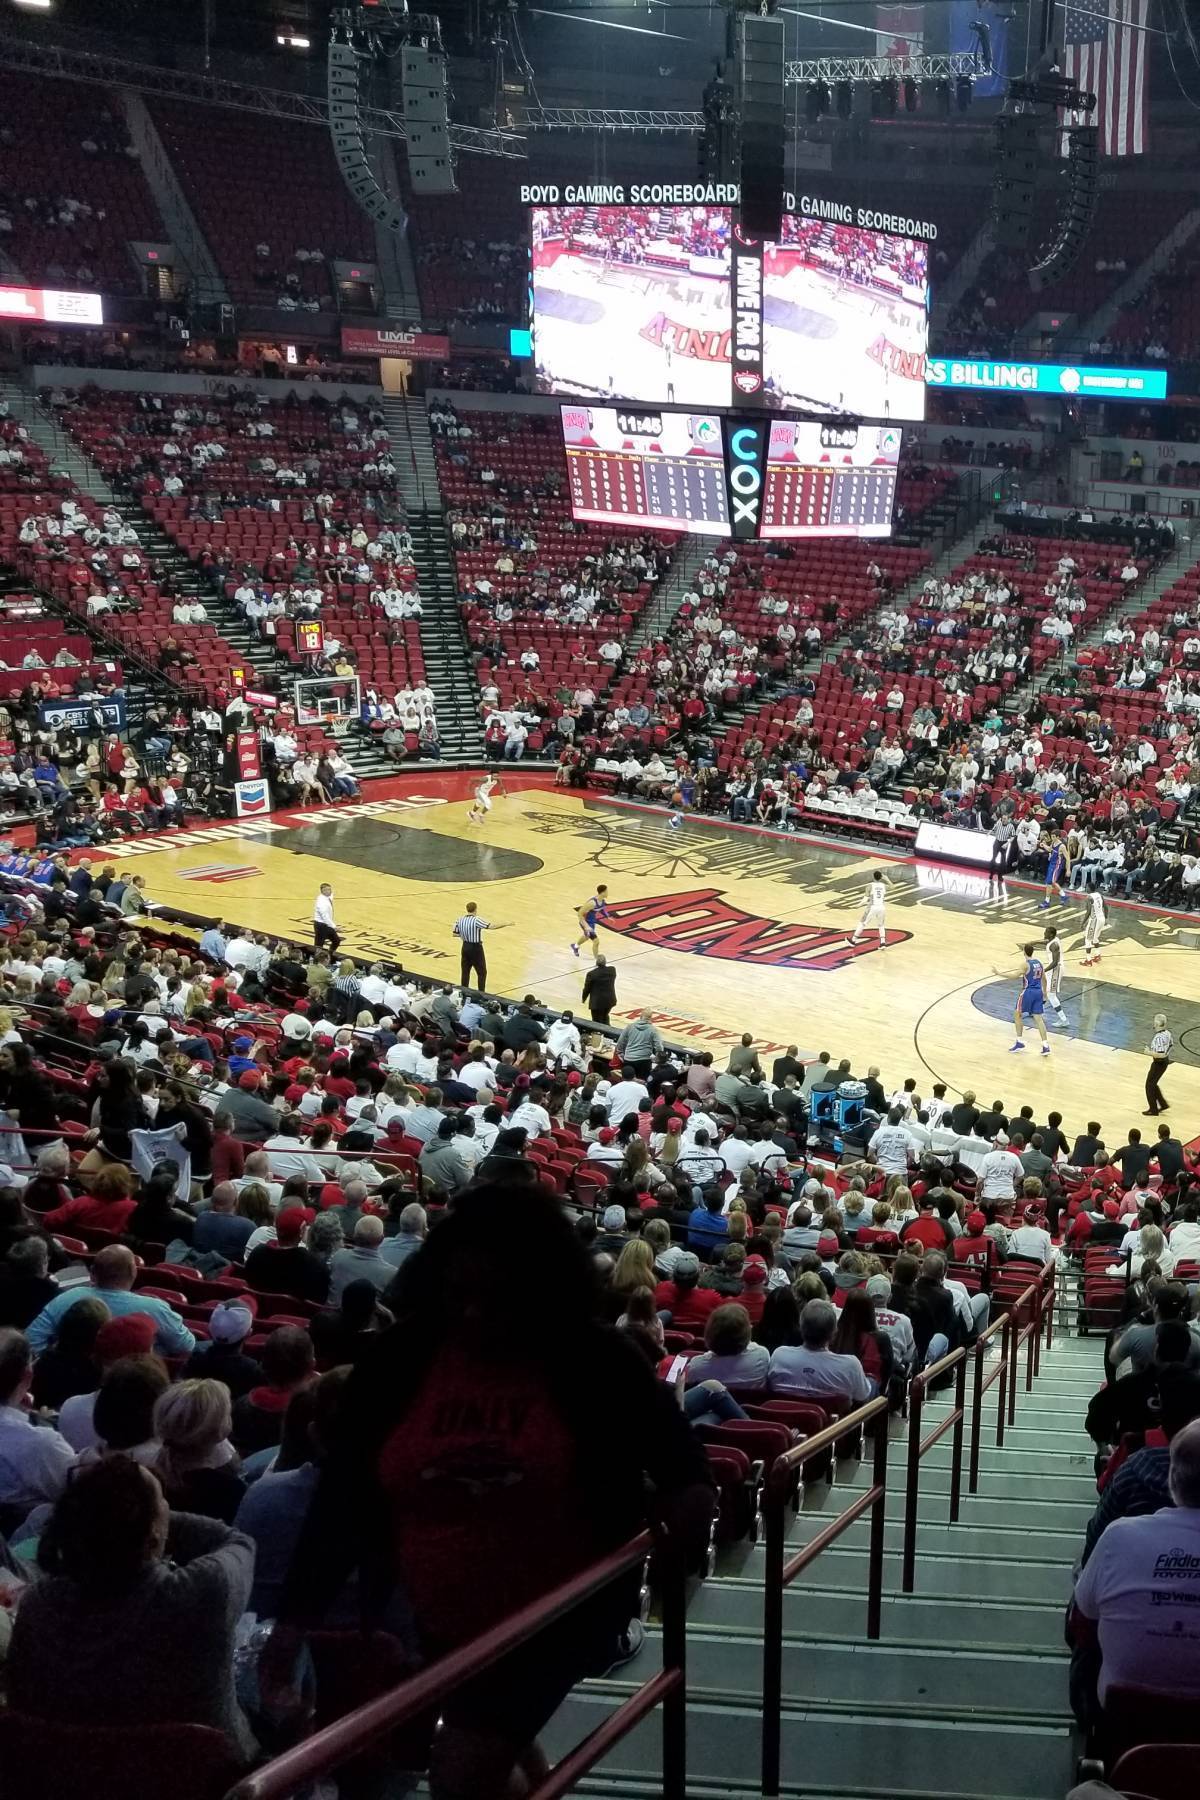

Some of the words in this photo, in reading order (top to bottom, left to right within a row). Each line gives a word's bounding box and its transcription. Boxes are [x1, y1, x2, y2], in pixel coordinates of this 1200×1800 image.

[520, 185, 560, 203] BOYD
[564, 185, 624, 203] GAMING
[630, 184, 738, 203] SCOREBOARD
[800, 195, 852, 222] GAMING
[857, 208, 937, 240] SCOREBOARD
[736, 256, 760, 314] DRIVE
[377, 330, 416, 344] UMC
[736, 315, 760, 348] FOR
[736, 350, 760, 362] 5
[950, 363, 1039, 389] BILLING!
[618, 415, 663, 434] 11:45
[821, 428, 858, 446] 11:45
[572, 457, 577, 465] 3
[589, 459, 594, 468] 3
[602, 460, 608, 469] 3
[618, 462, 623, 471] 1
[633, 464, 639, 472] 0
[590, 469, 595, 478] 0
[603, 471, 609, 479] 0
[619, 472, 624, 481] 1
[634, 474, 640, 482] 0
[668, 467, 673, 475] 0
[682, 468, 687, 476] 1
[699, 469, 704, 478] 0
[715, 471, 721, 479] 0
[730, 428, 761, 525] COX
[573, 478, 581, 486] 13
[591, 480, 597, 488] 0
[604, 481, 610, 490] 0
[620, 483, 626, 491] 0
[635, 484, 641, 493] 0
[669, 477, 674, 485] 3
[683, 479, 688, 487] 1
[700, 480, 705, 488] 1
[716, 481, 722, 490] 0
[574, 488, 582, 496] 24
[592, 490, 597, 499] 3
[605, 491, 610, 500] 2
[621, 493, 627, 502] 0
[637, 495, 642, 503] 0
[670, 488, 675, 496] 0
[684, 489, 689, 497] 0
[701, 491, 706, 499] 0
[717, 492, 724, 500] 0
[575, 498, 583, 506] 30
[593, 500, 598, 508] 1
[606, 502, 612, 510] 0
[622, 504, 628, 512] 0
[638, 505, 643, 513] 0
[652, 496, 660, 504] 21
[671, 498, 676, 506] 3
[685, 500, 690, 508] 1
[702, 501, 707, 510] 1
[718, 503, 724, 511] 0
[686, 510, 691, 518] 0
[703, 512, 707, 520] 1
[720, 513, 724, 521] 1
[306, 633, 320, 649] 18
[66, 710, 83, 720] CBS
[239, 782, 265, 791] Chevron
[102, 818, 291, 858] RUNNIN
[290, 794, 450, 824] REBELS
[574, 887, 915, 971] UNLV
[354, 931, 457, 960] AMERICA
[927, 1104, 938, 1119] 20
